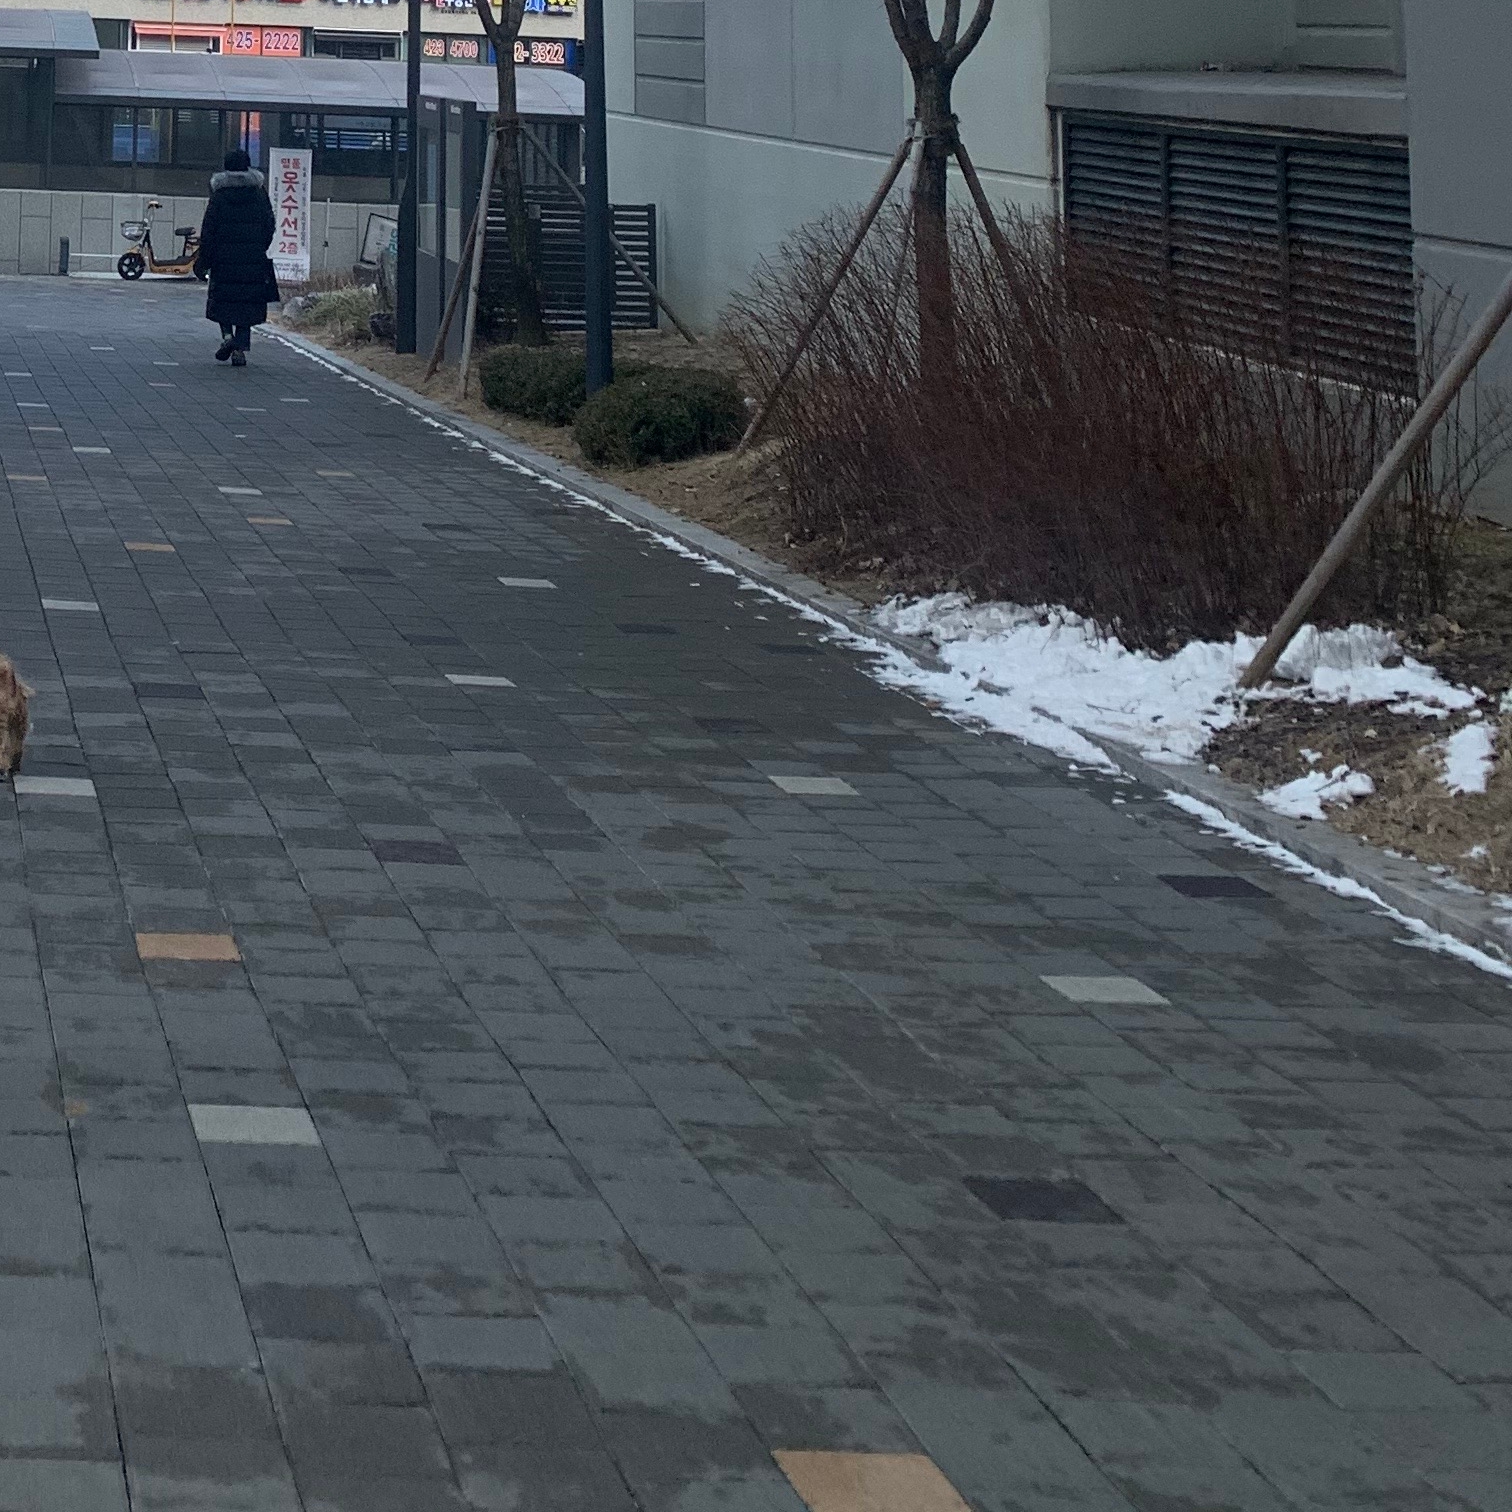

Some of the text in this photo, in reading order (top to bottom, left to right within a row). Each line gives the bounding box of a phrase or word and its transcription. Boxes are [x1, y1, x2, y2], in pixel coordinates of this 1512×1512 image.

[264, 31, 300, 52] 2222
[423, 38, 446, 57] 423
[531, 41, 565, 64] 3322
[281, 171, 300, 239] 옷수선
[278, 241, 299, 255] 2층
